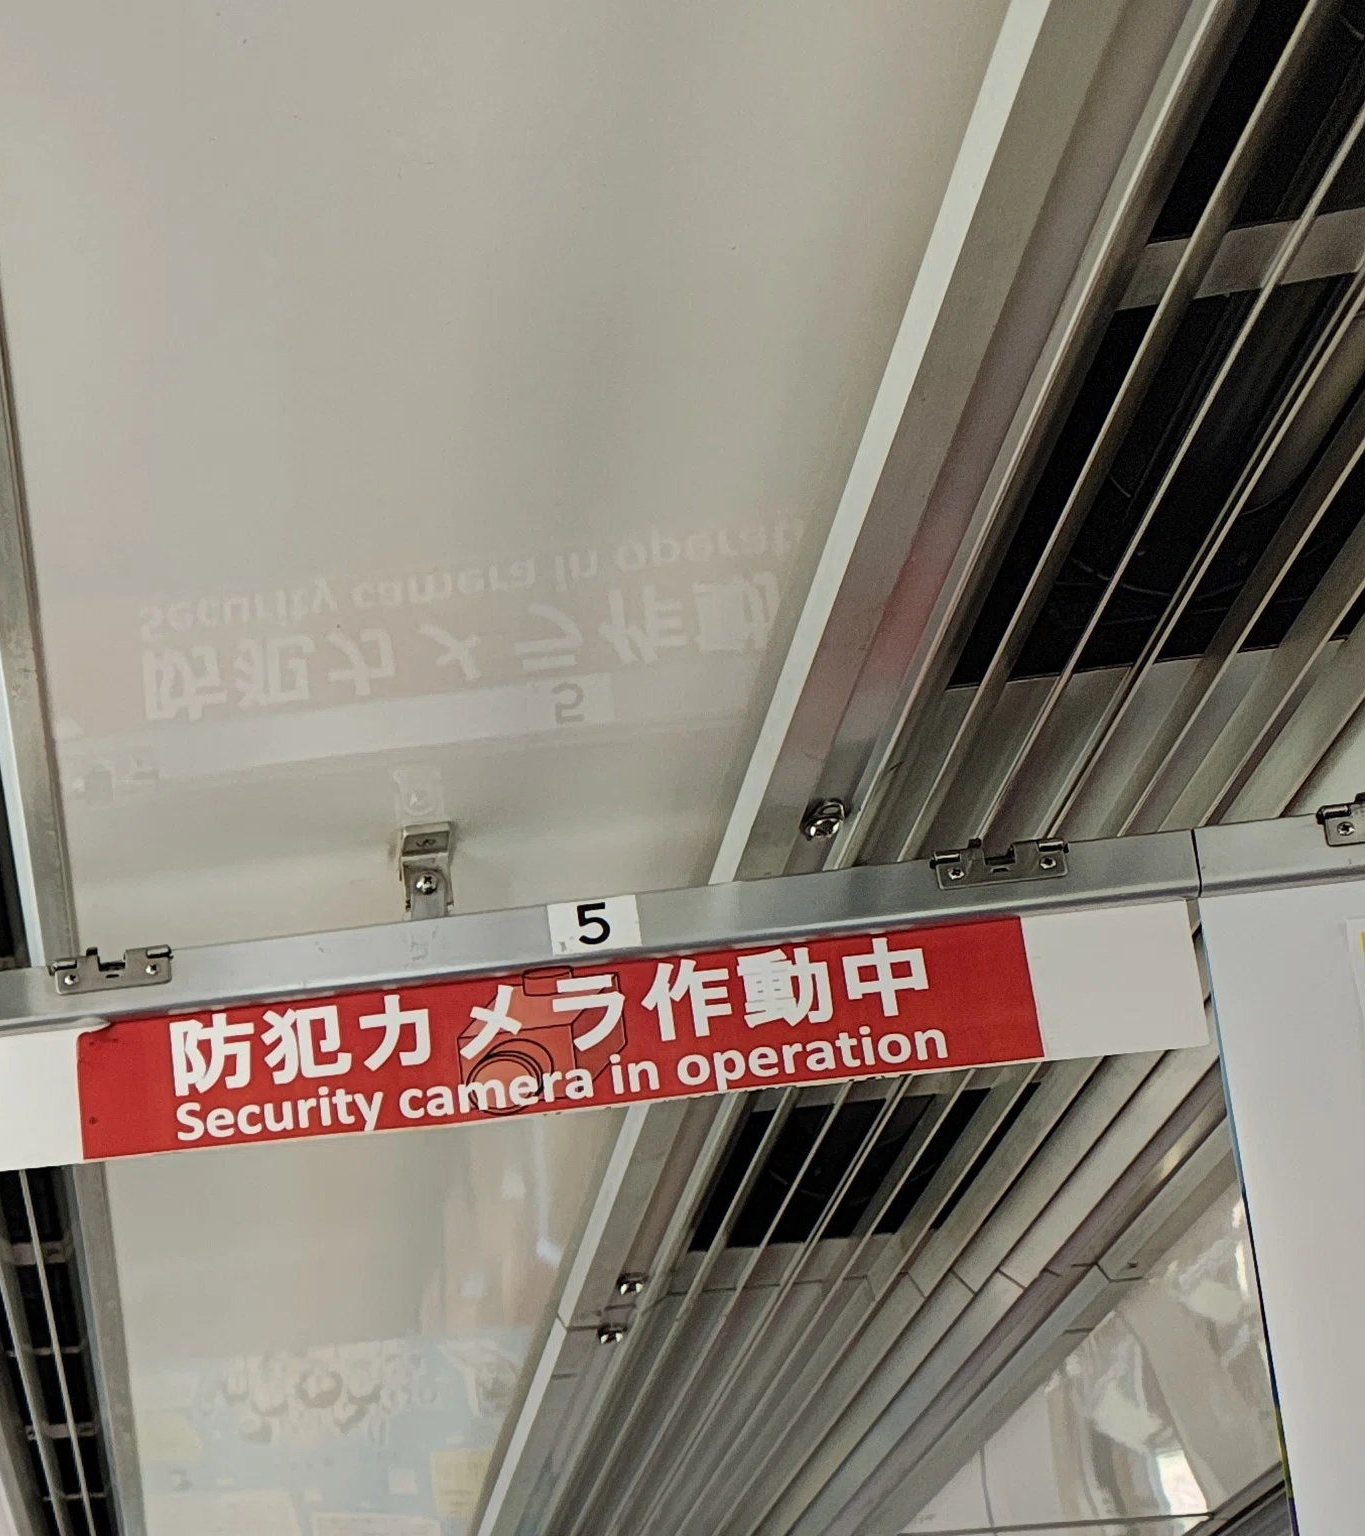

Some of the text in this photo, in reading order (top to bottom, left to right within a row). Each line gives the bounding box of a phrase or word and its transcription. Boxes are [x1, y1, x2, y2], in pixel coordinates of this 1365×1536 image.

[577, 904, 611, 944] 5
[170, 938, 931, 1096] 防犯カメラ作動中
[175, 1023, 949, 1142] Security camera in operation
